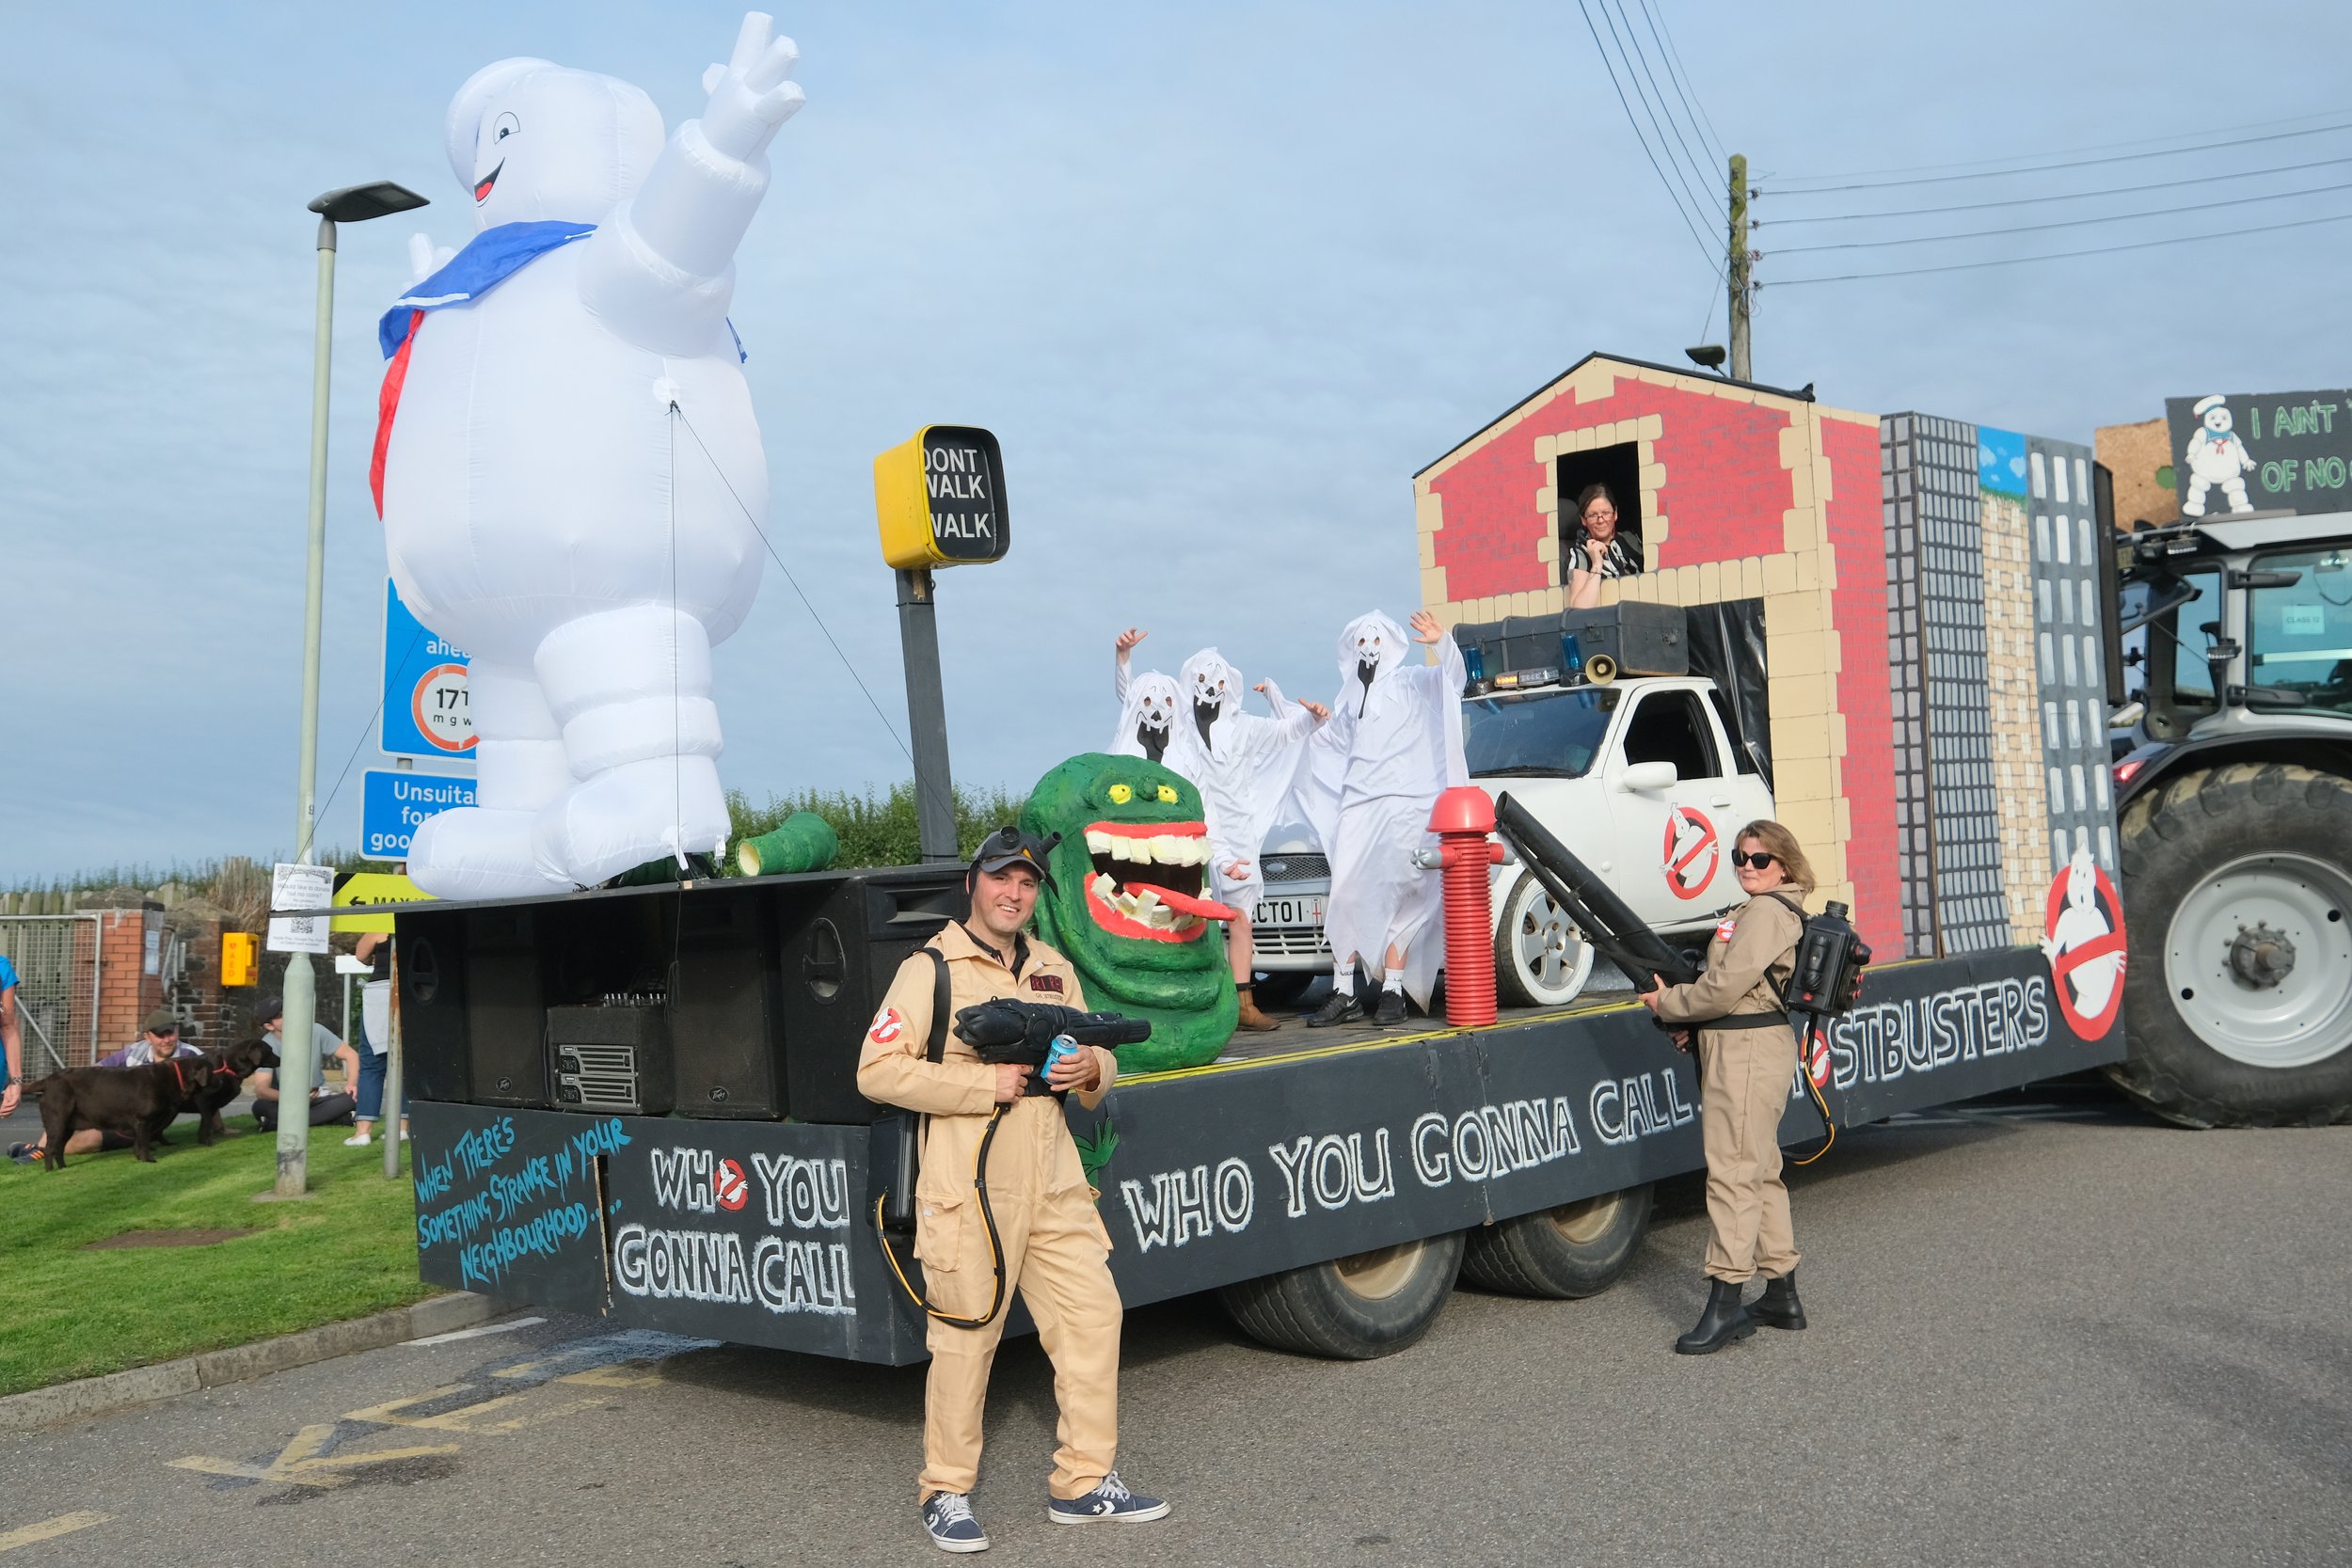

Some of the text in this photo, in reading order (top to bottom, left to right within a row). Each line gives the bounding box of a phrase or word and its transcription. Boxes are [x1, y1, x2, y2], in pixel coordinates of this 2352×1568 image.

[2251, 406, 2262, 439] I
[2261, 455, 2346, 493] OF NO
[393, 781, 478, 805] Unsuita
[415, 1116, 516, 1204] WHEN THERE'S
[418, 1117, 633, 1250] SOMETHING STRANGE IN YOUR
[750, 1152, 850, 1228] YOU
[1120, 1156, 1255, 1253] WHO
[1269, 1127, 1395, 1218] YOU
[1410, 1096, 1582, 1188] GONNA
[614, 1223, 857, 1315] GONNA CALL
